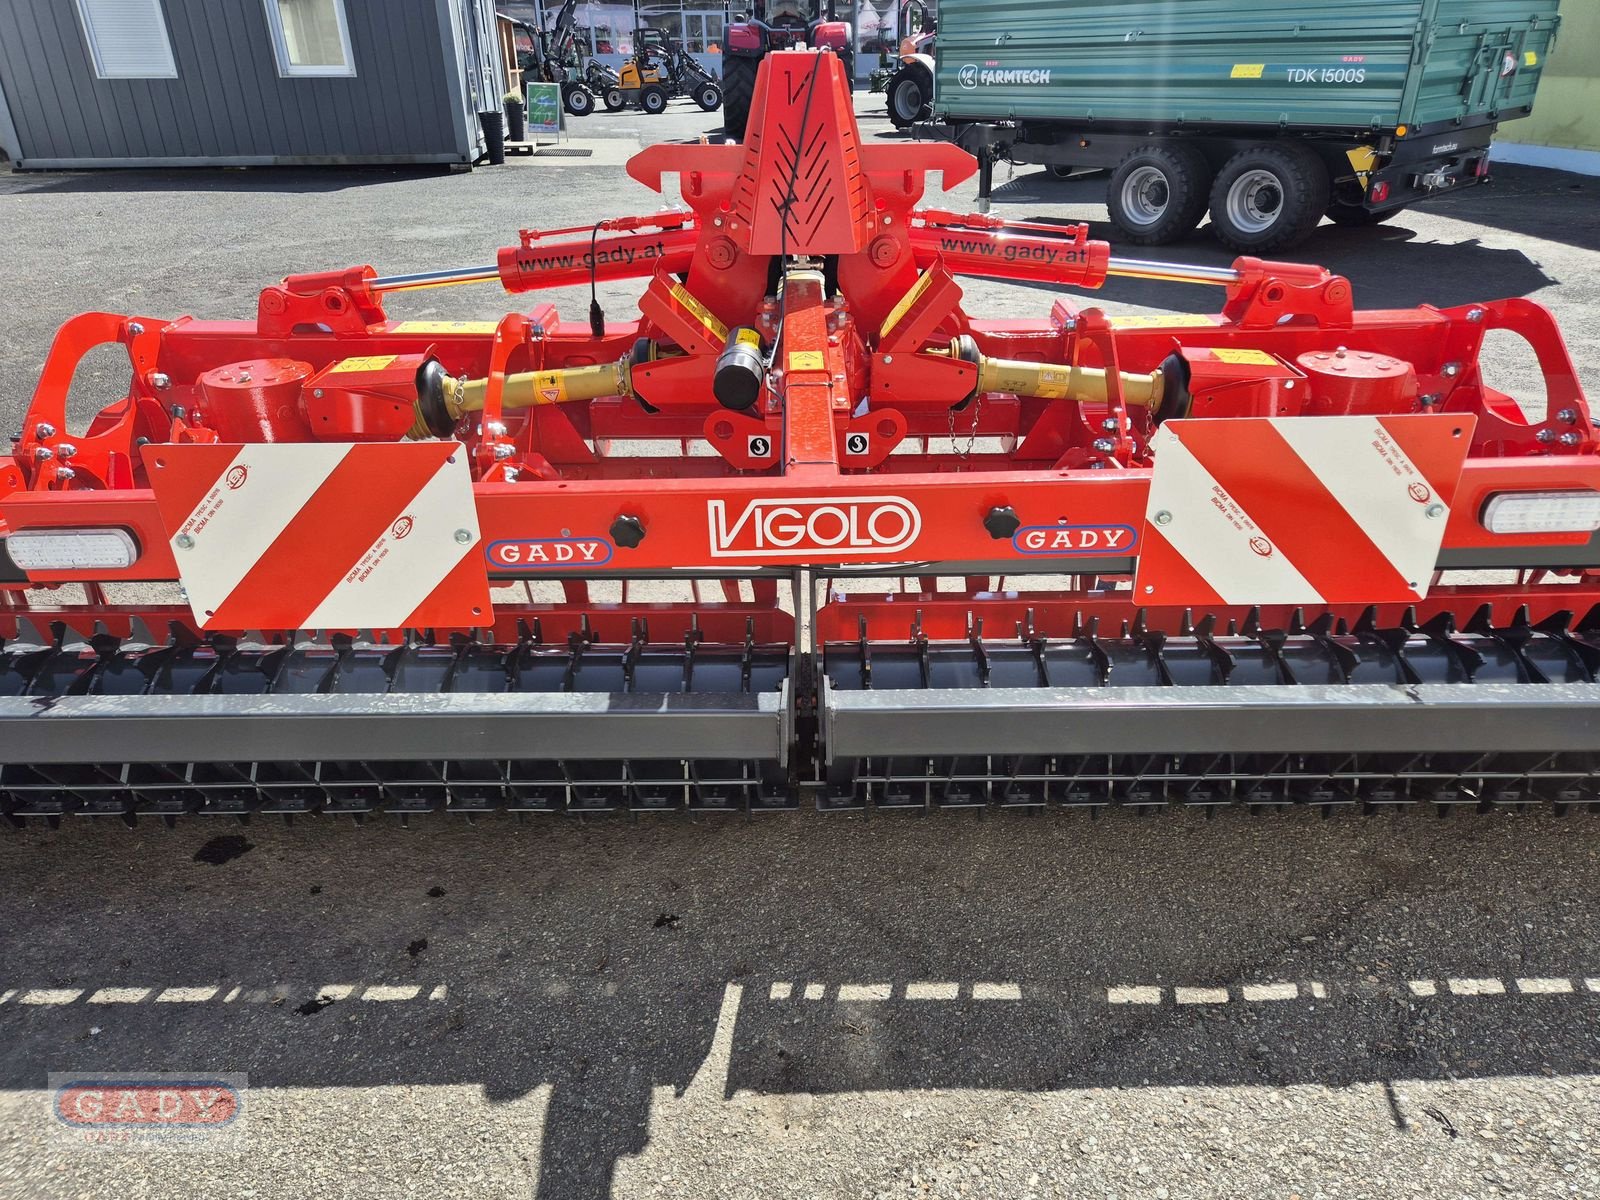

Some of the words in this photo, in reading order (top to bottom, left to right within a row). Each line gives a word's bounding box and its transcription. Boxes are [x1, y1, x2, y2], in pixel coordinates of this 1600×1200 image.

[980, 69, 1051, 86] FARMTECH
[1287, 68, 1317, 83] TDK
[1320, 68, 1365, 83] 1500S
[518, 241, 666, 273] www.gady.at
[941, 238, 1088, 263] www.gady.at
[194, 516, 208, 534] BICMA
[707, 495, 922, 558] VIGOLO
[1025, 530, 1124, 548] GADY
[500, 543, 598, 564] GADY
[346, 568, 360, 584] BICMA
[358, 566, 374, 582] BICMA
